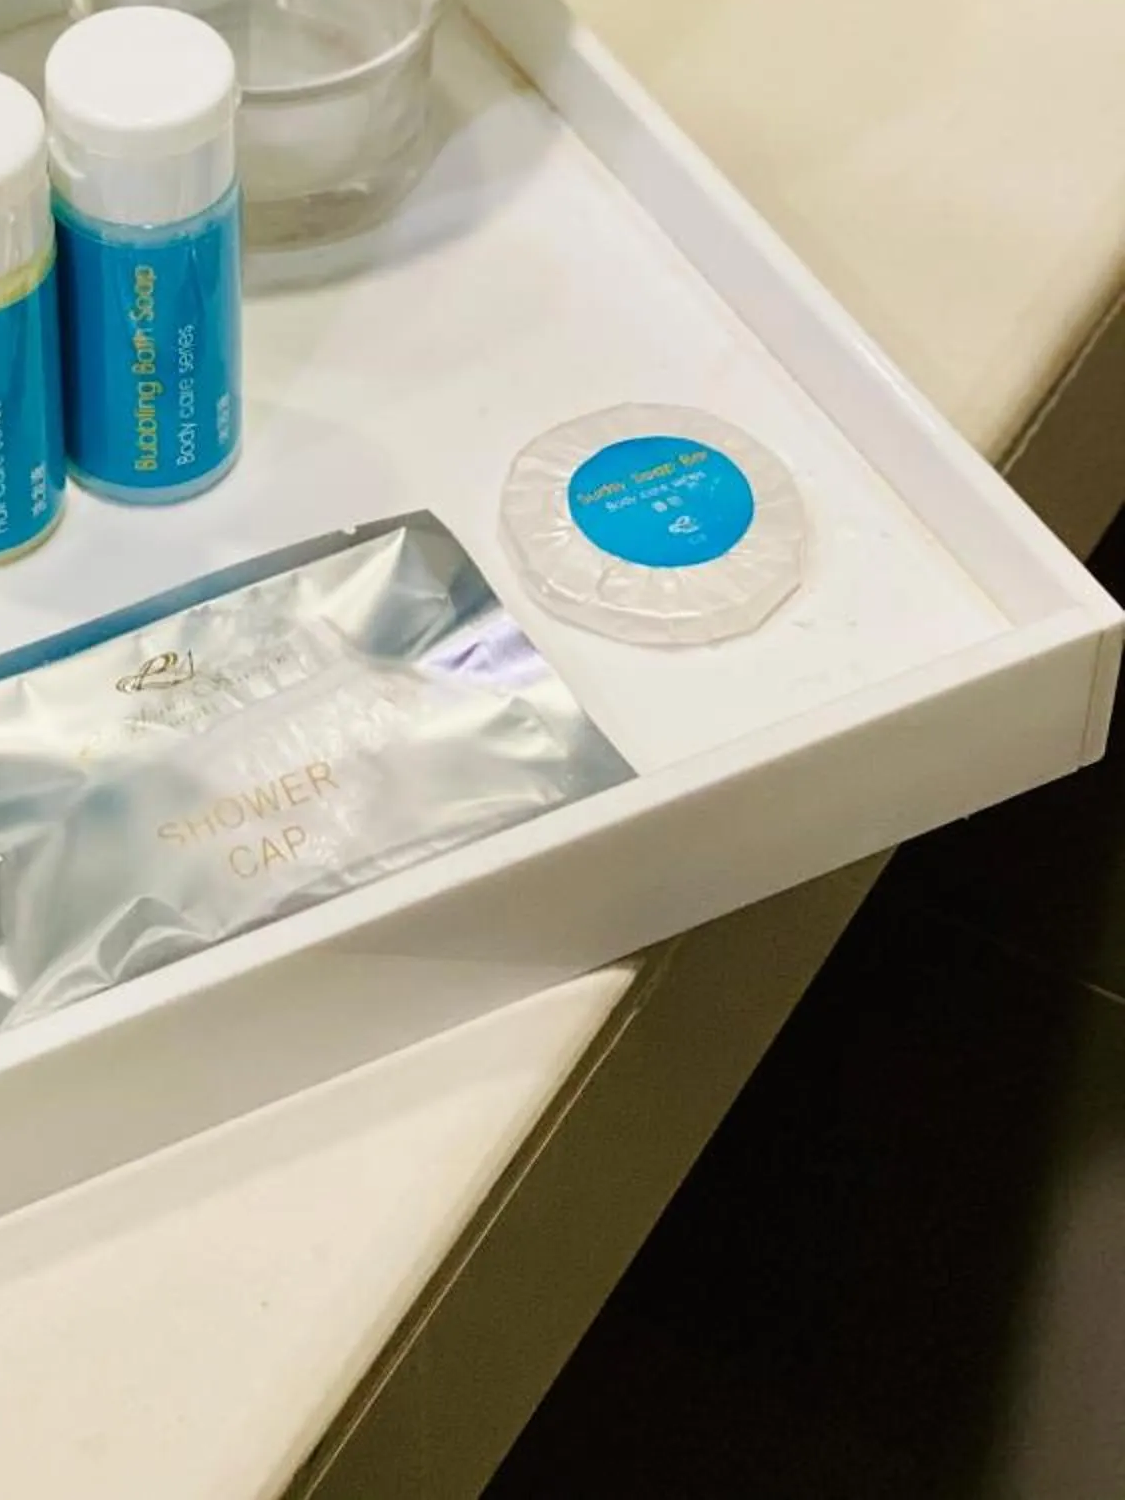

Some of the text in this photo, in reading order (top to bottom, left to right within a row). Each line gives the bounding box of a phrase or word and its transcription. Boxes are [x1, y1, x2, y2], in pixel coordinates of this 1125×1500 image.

[127, 265, 164, 471] Bubbling Bath Soap
[178, 378, 195, 418] care
[177, 422, 198, 466] Body
[157, 761, 339, 848] SHOWER
[229, 825, 307, 879] CAP
